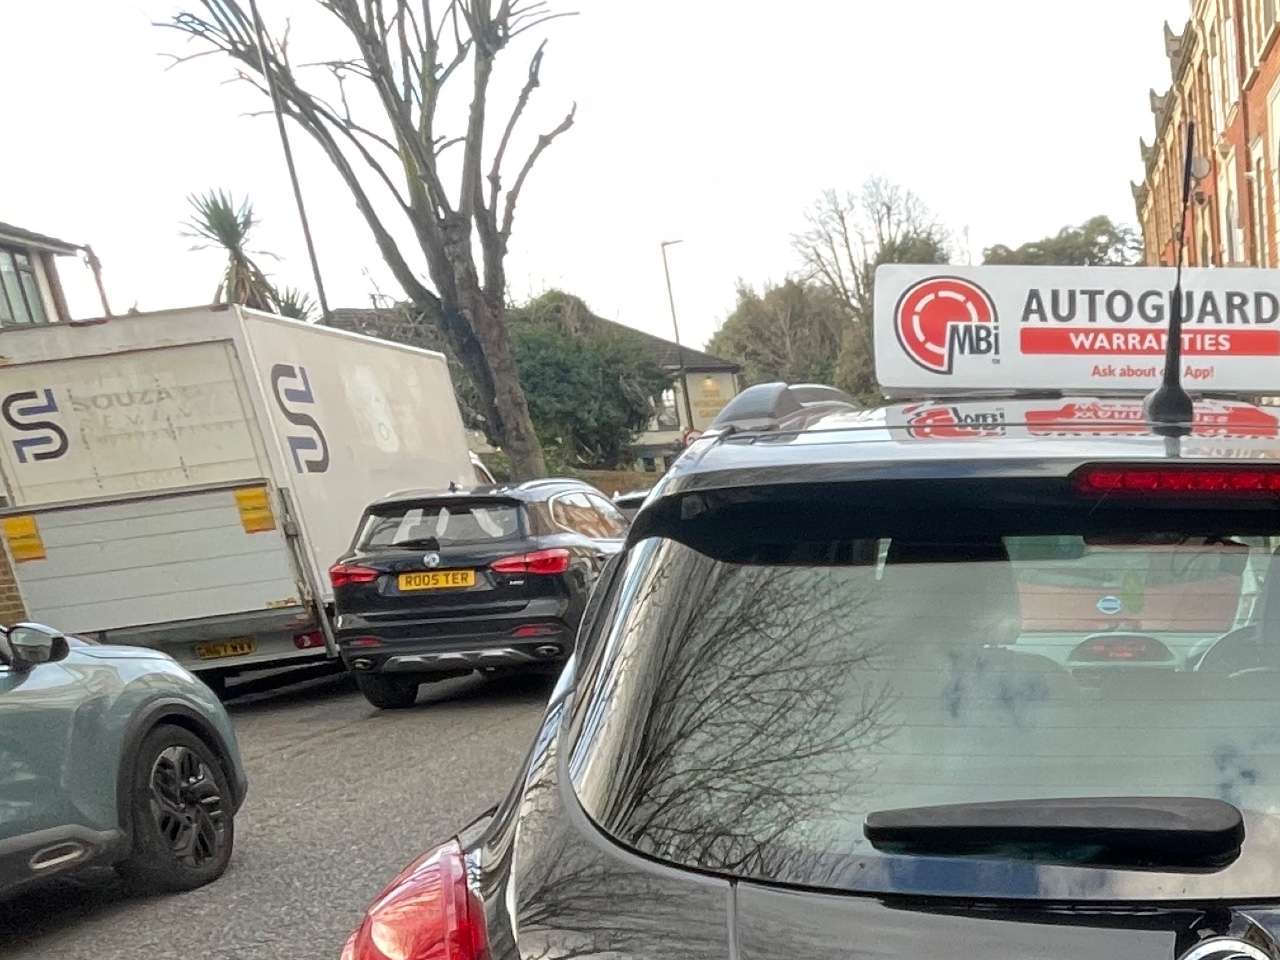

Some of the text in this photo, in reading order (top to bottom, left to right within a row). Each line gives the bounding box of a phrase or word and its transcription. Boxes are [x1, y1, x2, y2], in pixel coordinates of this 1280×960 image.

[1020, 287, 1280, 324] AUTOGUARD
[1091, 365, 1116, 378] Ask
[1119, 365, 1156, 378] about
[1184, 366, 1214, 379] App!
[444, 571, 469, 585] TER
